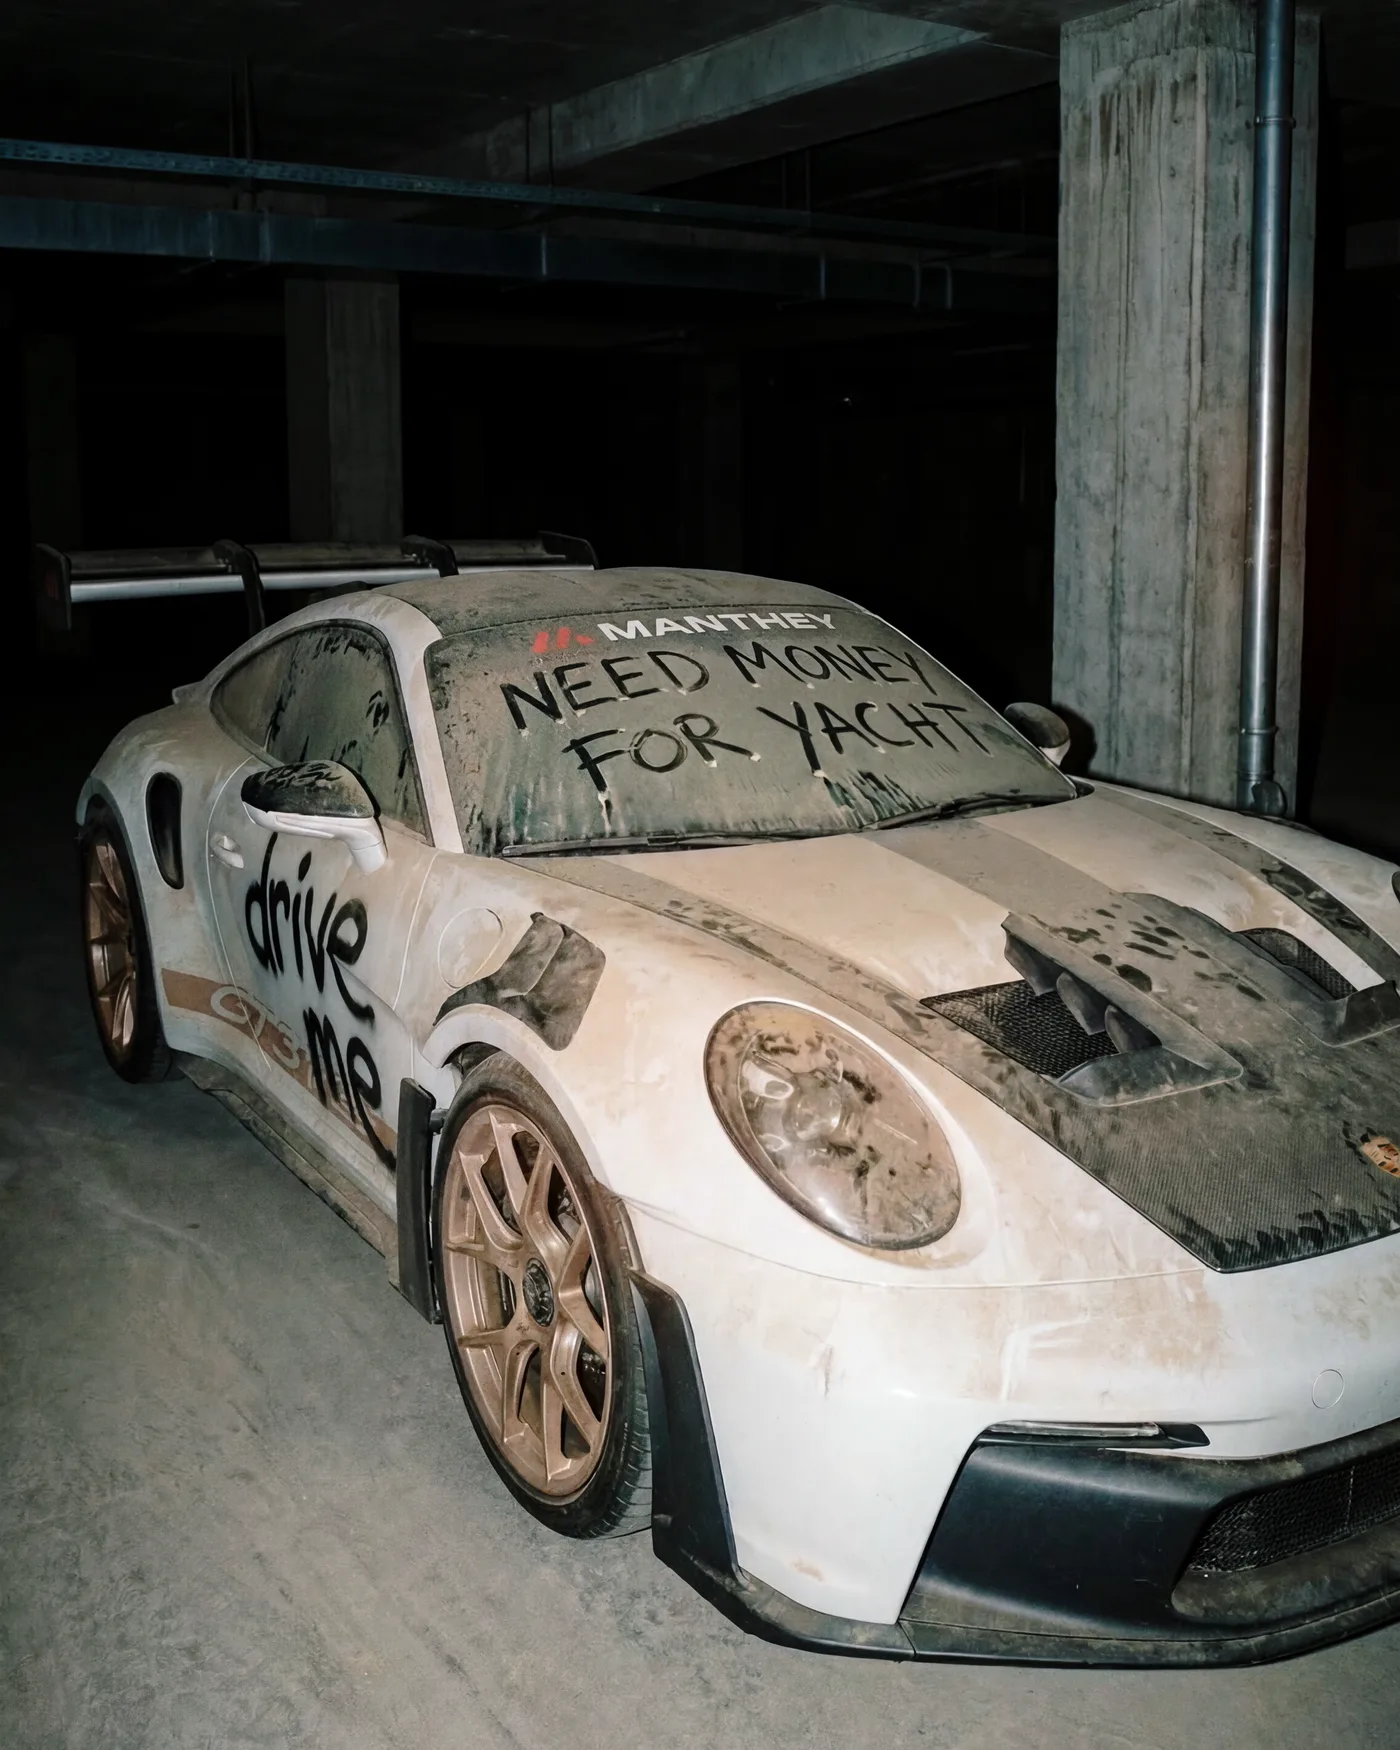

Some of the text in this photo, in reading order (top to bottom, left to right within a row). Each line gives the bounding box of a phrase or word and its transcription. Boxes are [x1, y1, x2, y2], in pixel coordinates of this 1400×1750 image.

[597, 612, 837, 641] MANTHEY
[500, 641, 939, 731] NEED MONEY
[561, 701, 993, 793] FOR YACHT
[244, 832, 374, 1024] drive
[302, 1006, 398, 1171] me
